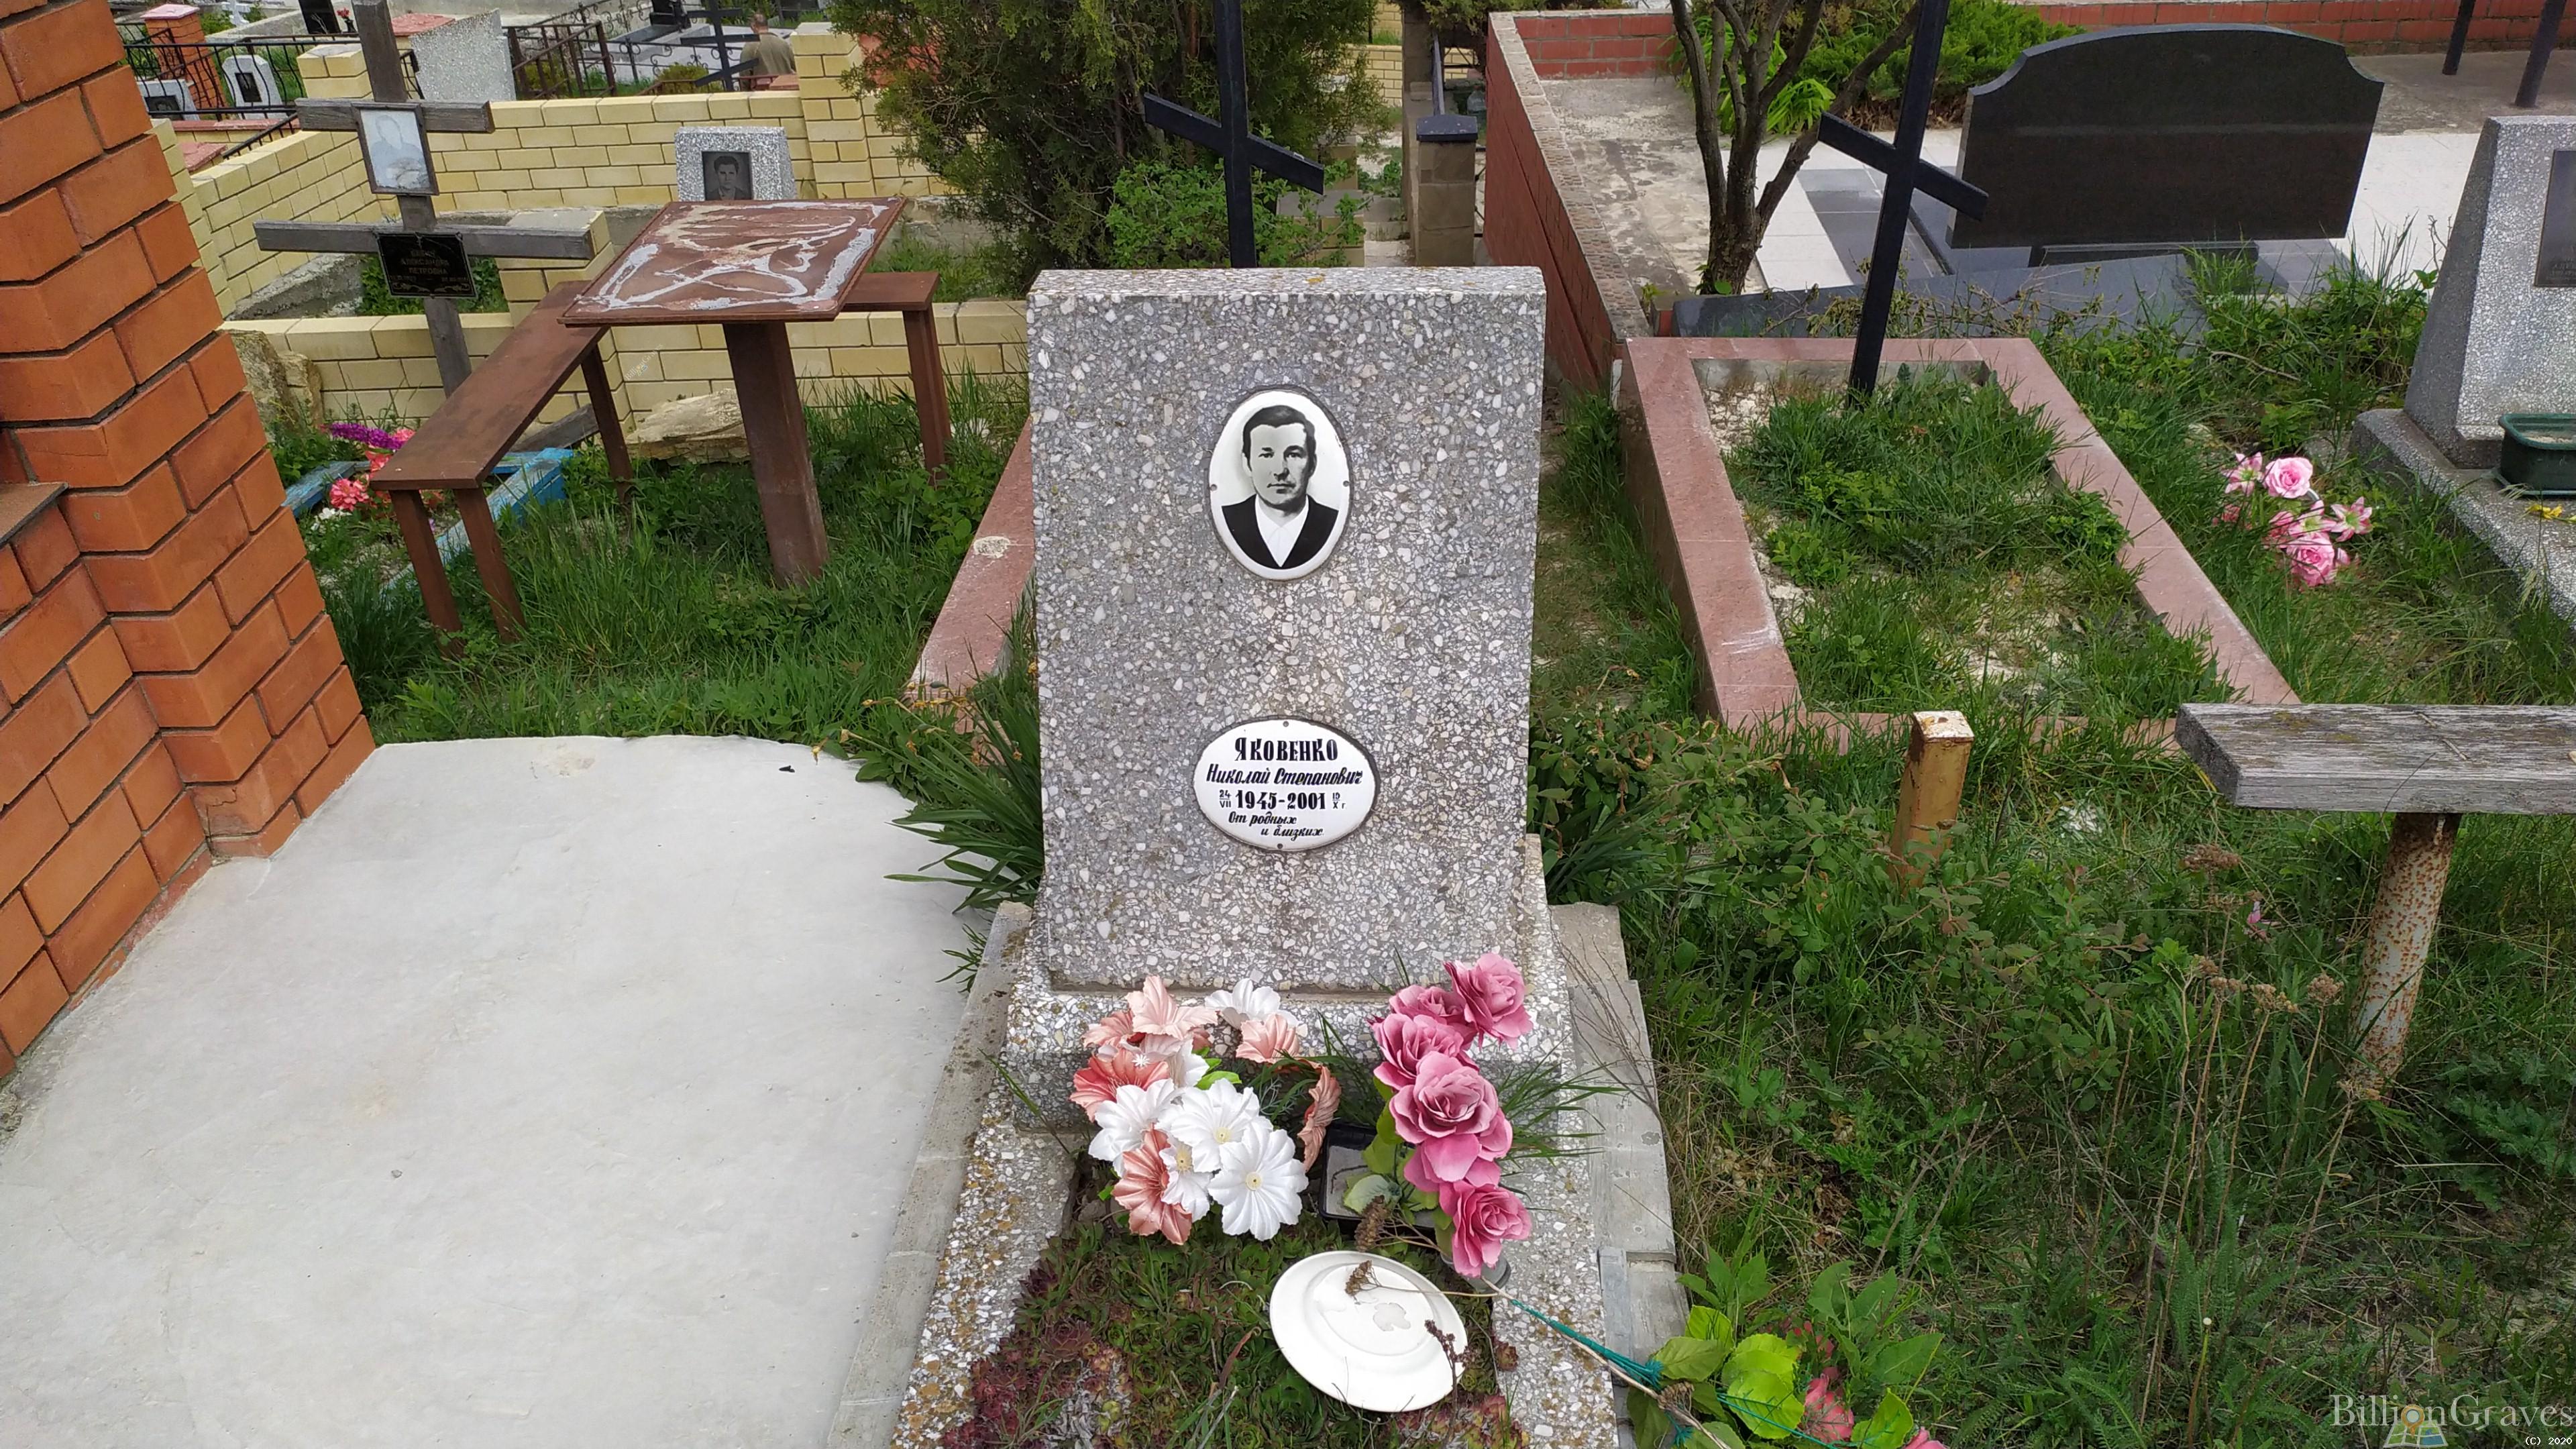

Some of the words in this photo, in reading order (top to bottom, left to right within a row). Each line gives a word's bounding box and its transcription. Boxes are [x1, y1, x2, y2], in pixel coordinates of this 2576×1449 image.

[1234, 737, 1338, 761] ЯКОВЕНКО
[1206, 763, 1270, 784] Николай
[1274, 767, 1363, 786] Степанович
[1219, 789, 1232, 798] 24
[1228, 811, 1247, 823] От
[1249, 812, 1297, 826] родных
[1260, 828, 1269, 836] и
[1273, 825, 1324, 841] близких
